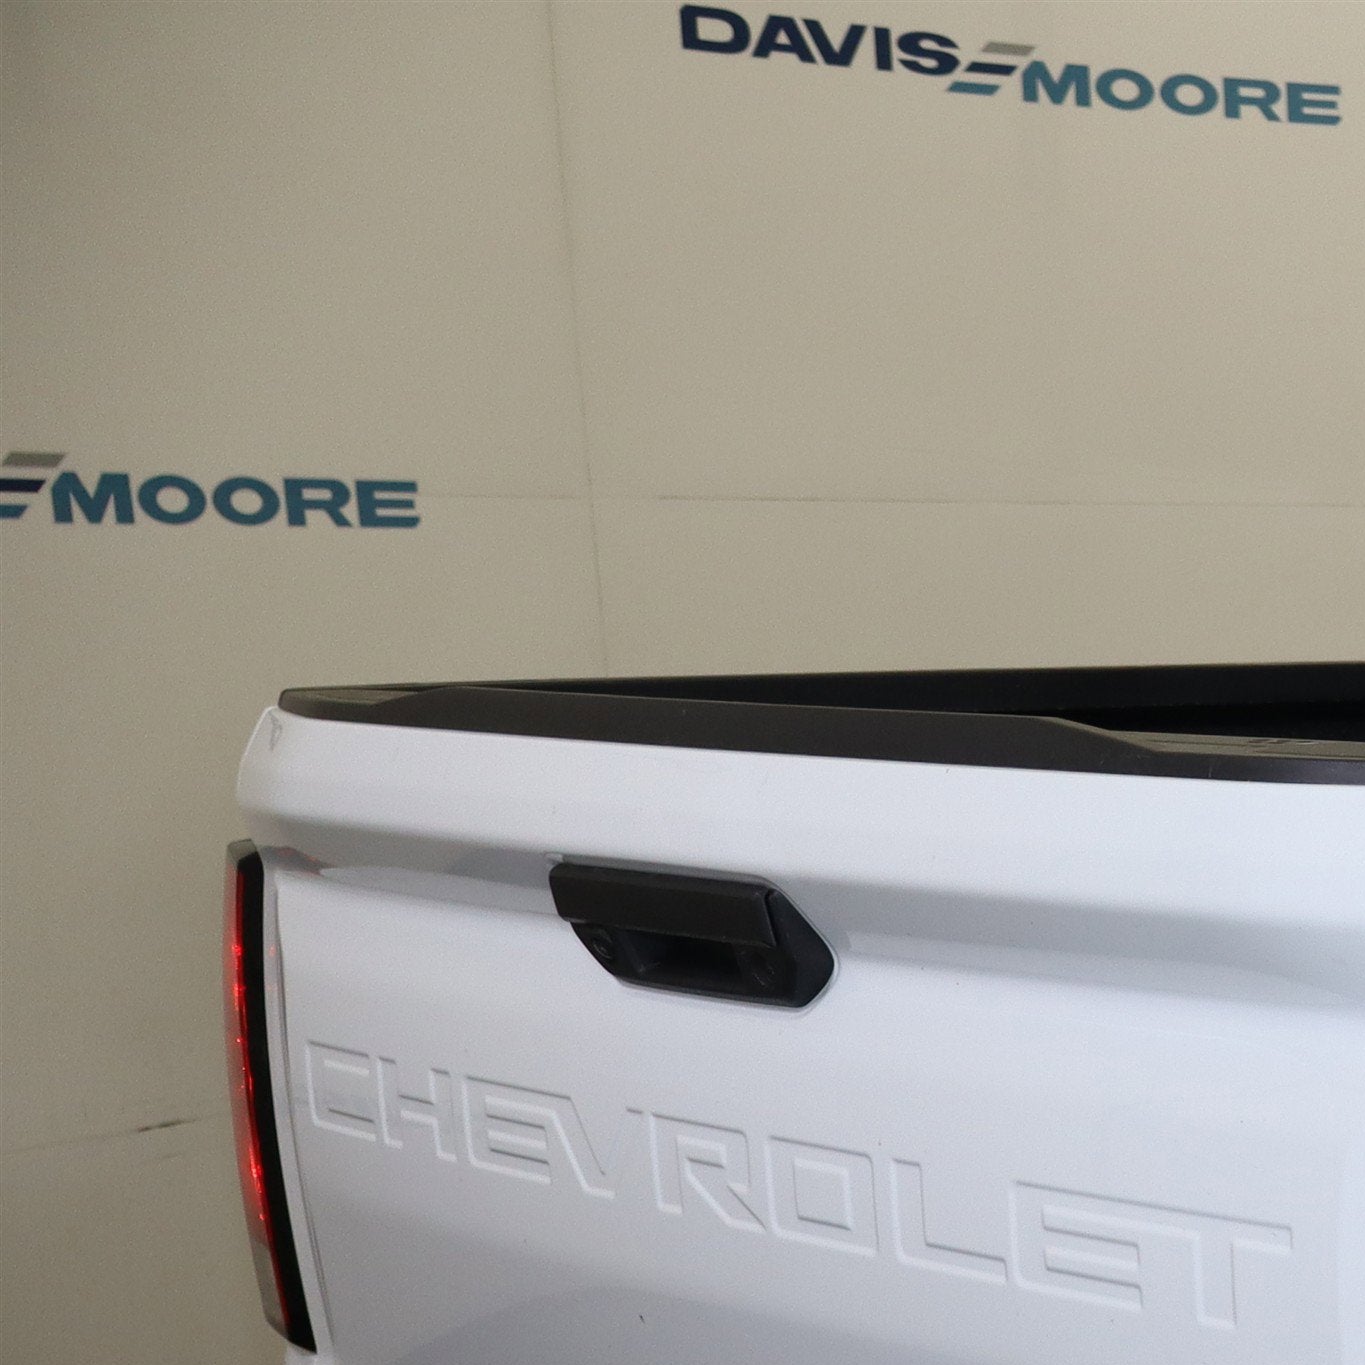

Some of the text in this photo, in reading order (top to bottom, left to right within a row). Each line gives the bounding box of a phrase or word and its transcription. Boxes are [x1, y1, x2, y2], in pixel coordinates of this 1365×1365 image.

[679, 3, 1342, 126] DAVIS MOORE
[51, 471, 421, 528] MOORE
[305, 1039, 1293, 1330] CHEVROLET
